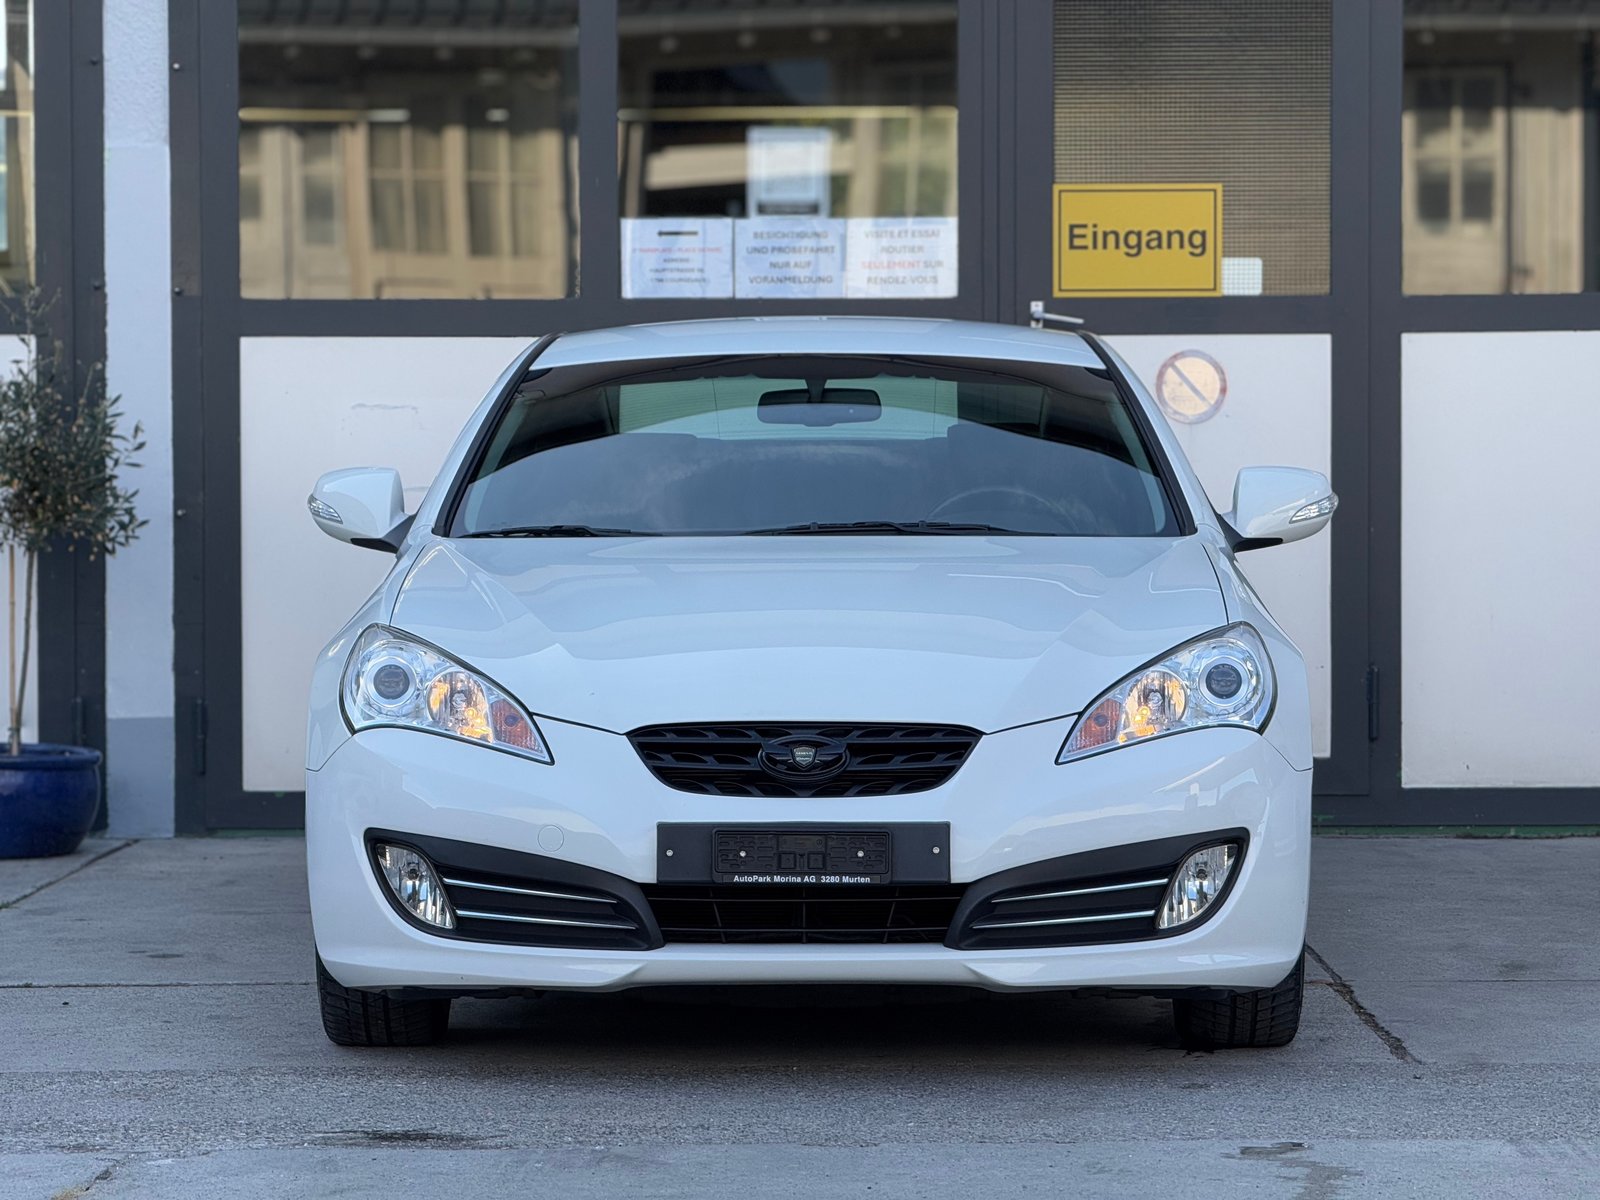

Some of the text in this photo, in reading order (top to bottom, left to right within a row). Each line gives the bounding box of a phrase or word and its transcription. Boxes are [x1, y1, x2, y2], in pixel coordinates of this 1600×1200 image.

[753, 230, 829, 240] BESICHTIGUNG
[864, 229, 895, 239] VISITE
[911, 229, 940, 239] ESSAI
[1068, 223, 1207, 258] Eingang
[746, 246, 835, 255] UND PROBEFAHRT
[880, 245, 924, 254] ROUTIER
[769, 261, 811, 269] NUR AUF
[861, 260, 944, 270] SEULEMENT SUR
[749, 275, 833, 284] VORANMELDUNG
[867, 276, 938, 285] RENDEZ-VOUS
[733, 874, 871, 884] AutoPark Morina AG 3280 Murten
